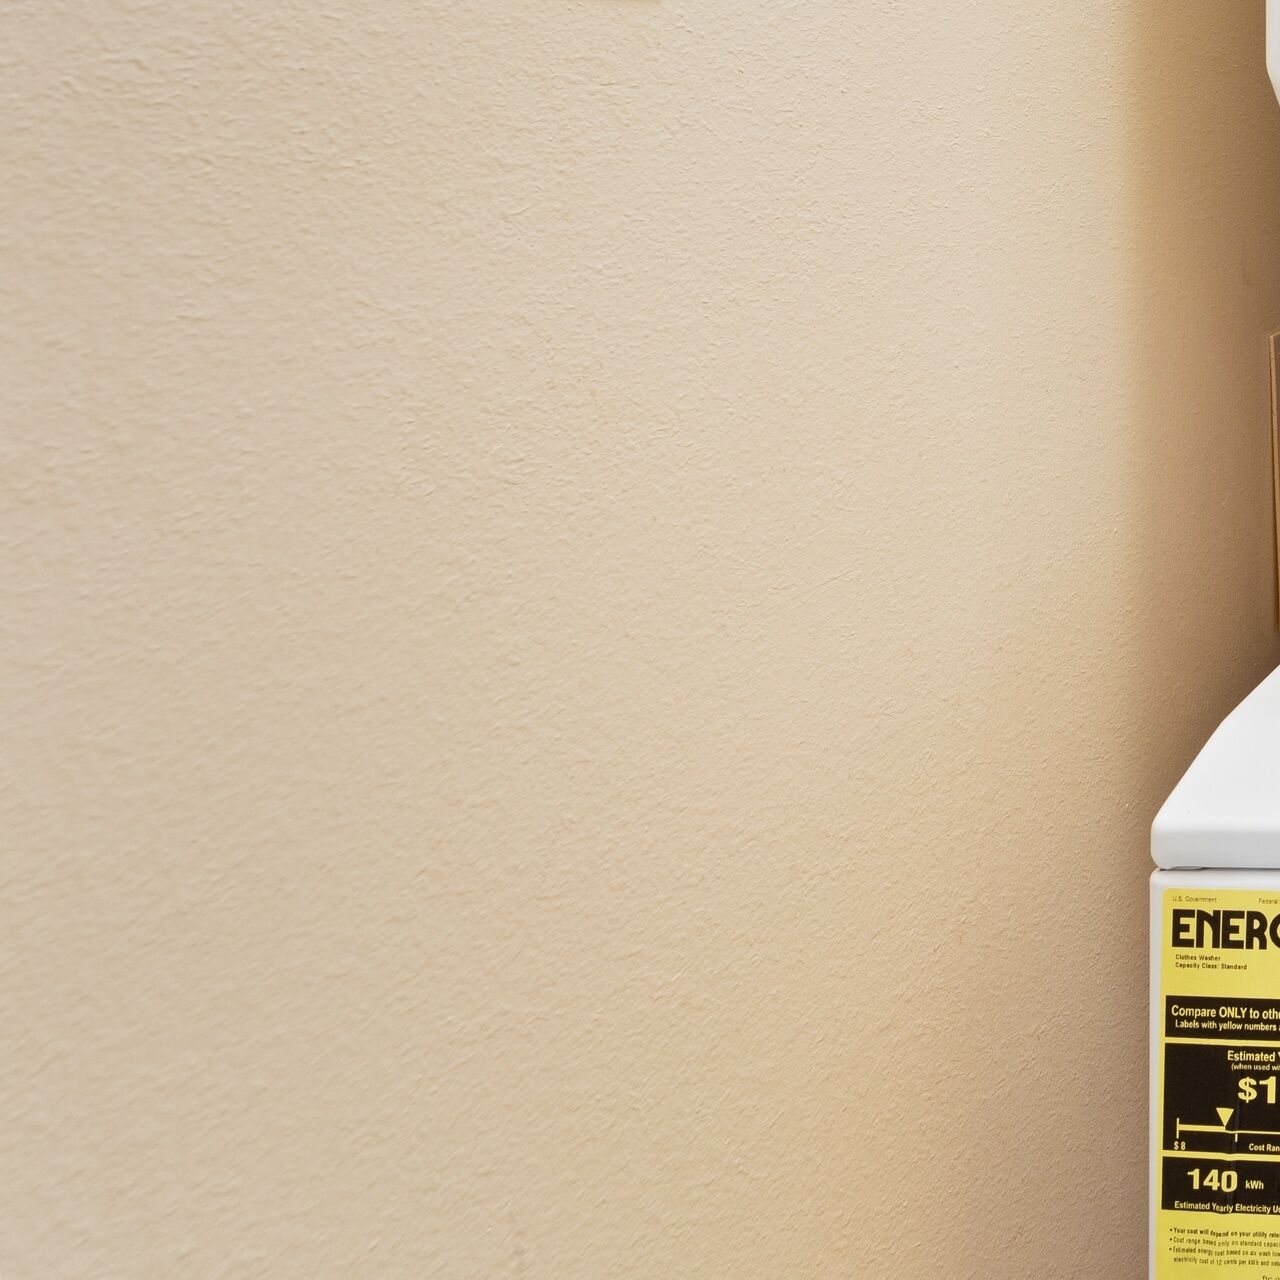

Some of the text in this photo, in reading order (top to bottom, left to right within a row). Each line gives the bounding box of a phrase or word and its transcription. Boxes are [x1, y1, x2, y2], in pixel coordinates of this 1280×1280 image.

[1171, 1005, 1216, 1019] Compare
[1219, 1006, 1247, 1019] ONLY
[1250, 1008, 1260, 1019] to
[1175, 1020, 1199, 1028] Labels
[1201, 1021, 1217, 1029] with
[1219, 1021, 1246, 1031] yellow
[1244, 1023, 1277, 1031] numbers
[1227, 1050, 1275, 1062] Estimated
[1249, 1143, 1265, 1151] Cost
[1187, 1168, 1264, 1192] 140 kWh
[1174, 1201, 1210, 1210] Estimated
[1211, 1203, 1234, 1213] Yearly
[1235, 1203, 1271, 1214] Electricity
